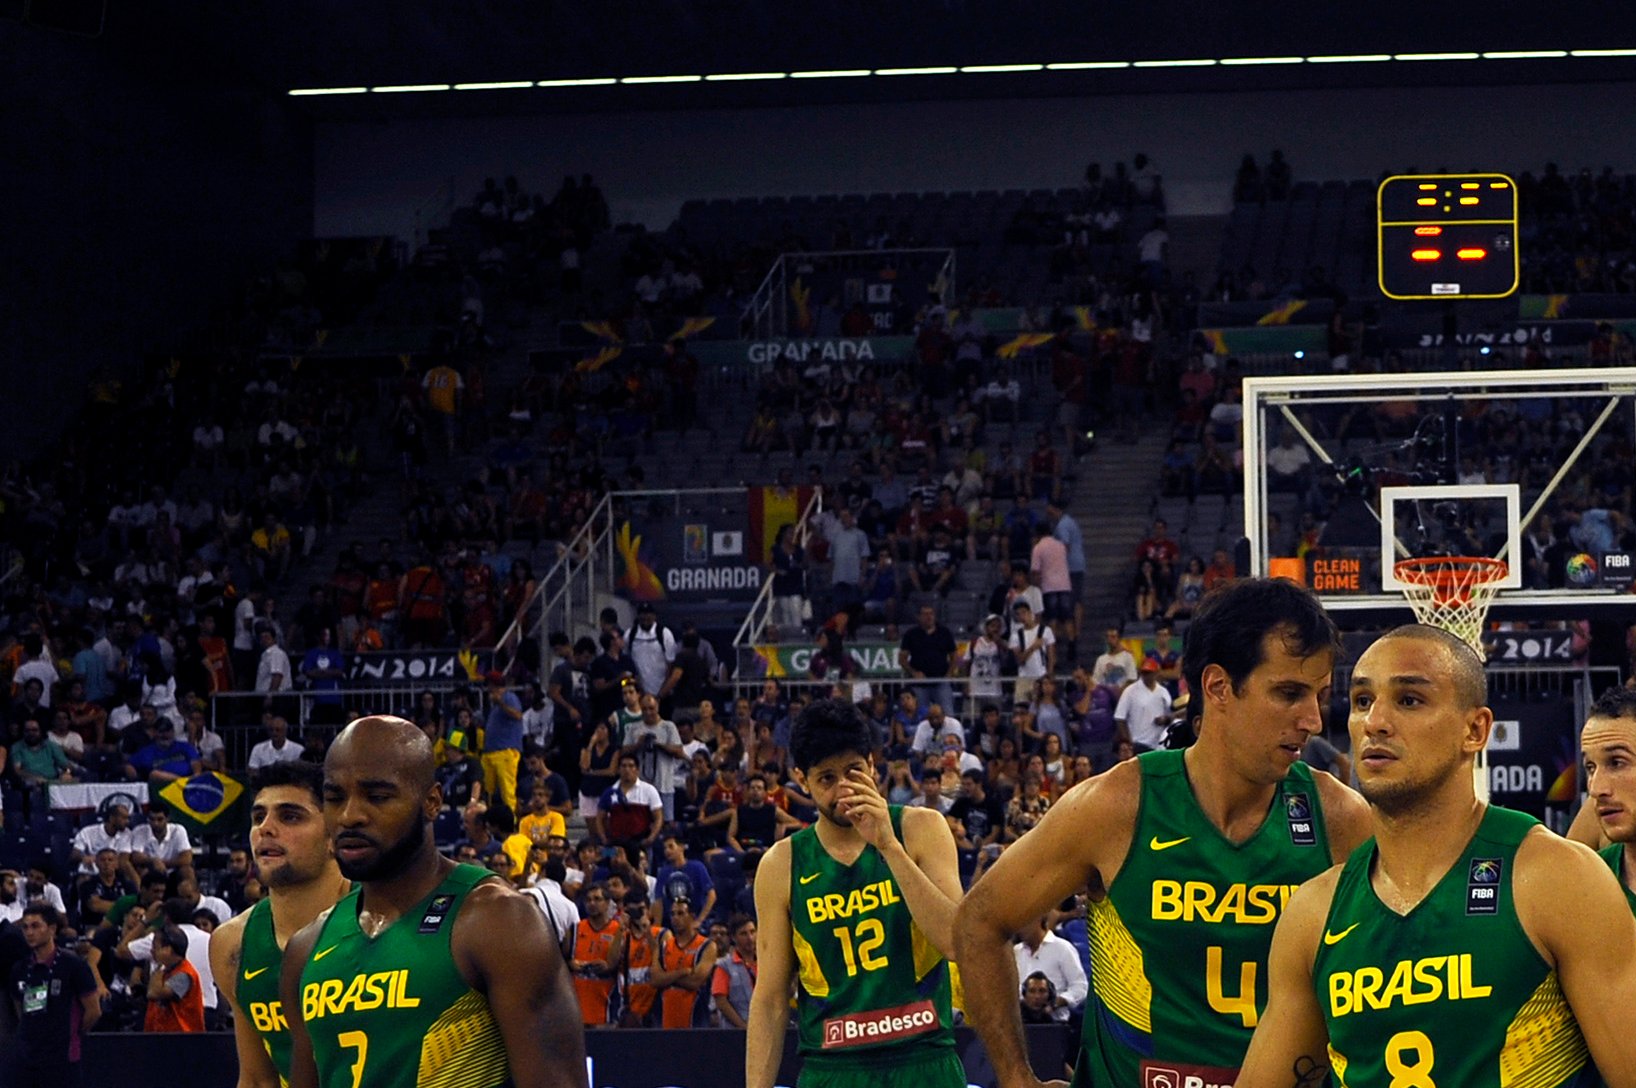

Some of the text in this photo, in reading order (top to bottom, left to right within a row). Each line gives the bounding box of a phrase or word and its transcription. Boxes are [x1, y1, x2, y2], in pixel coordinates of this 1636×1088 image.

[1313, 558, 1360, 575] CLEAN
[1605, 554, 1630, 568] FIBA
[667, 566, 760, 591] GRANADA
[1313, 574, 1360, 591] GAME
[1502, 636, 1571, 658] 2014
[390, 656, 455, 678] 2014
[806, 879, 901, 924] BRASIL
[1151, 879, 1301, 925] BRASI
[1471, 888, 1495, 899] FIBA
[832, 917, 889, 977] 12
[302, 969, 421, 1022] BRASIL
[1206, 945, 1259, 1028] 4
[1329, 953, 1493, 1018] BRASIL
[844, 1009, 935, 1039] Bradesco
